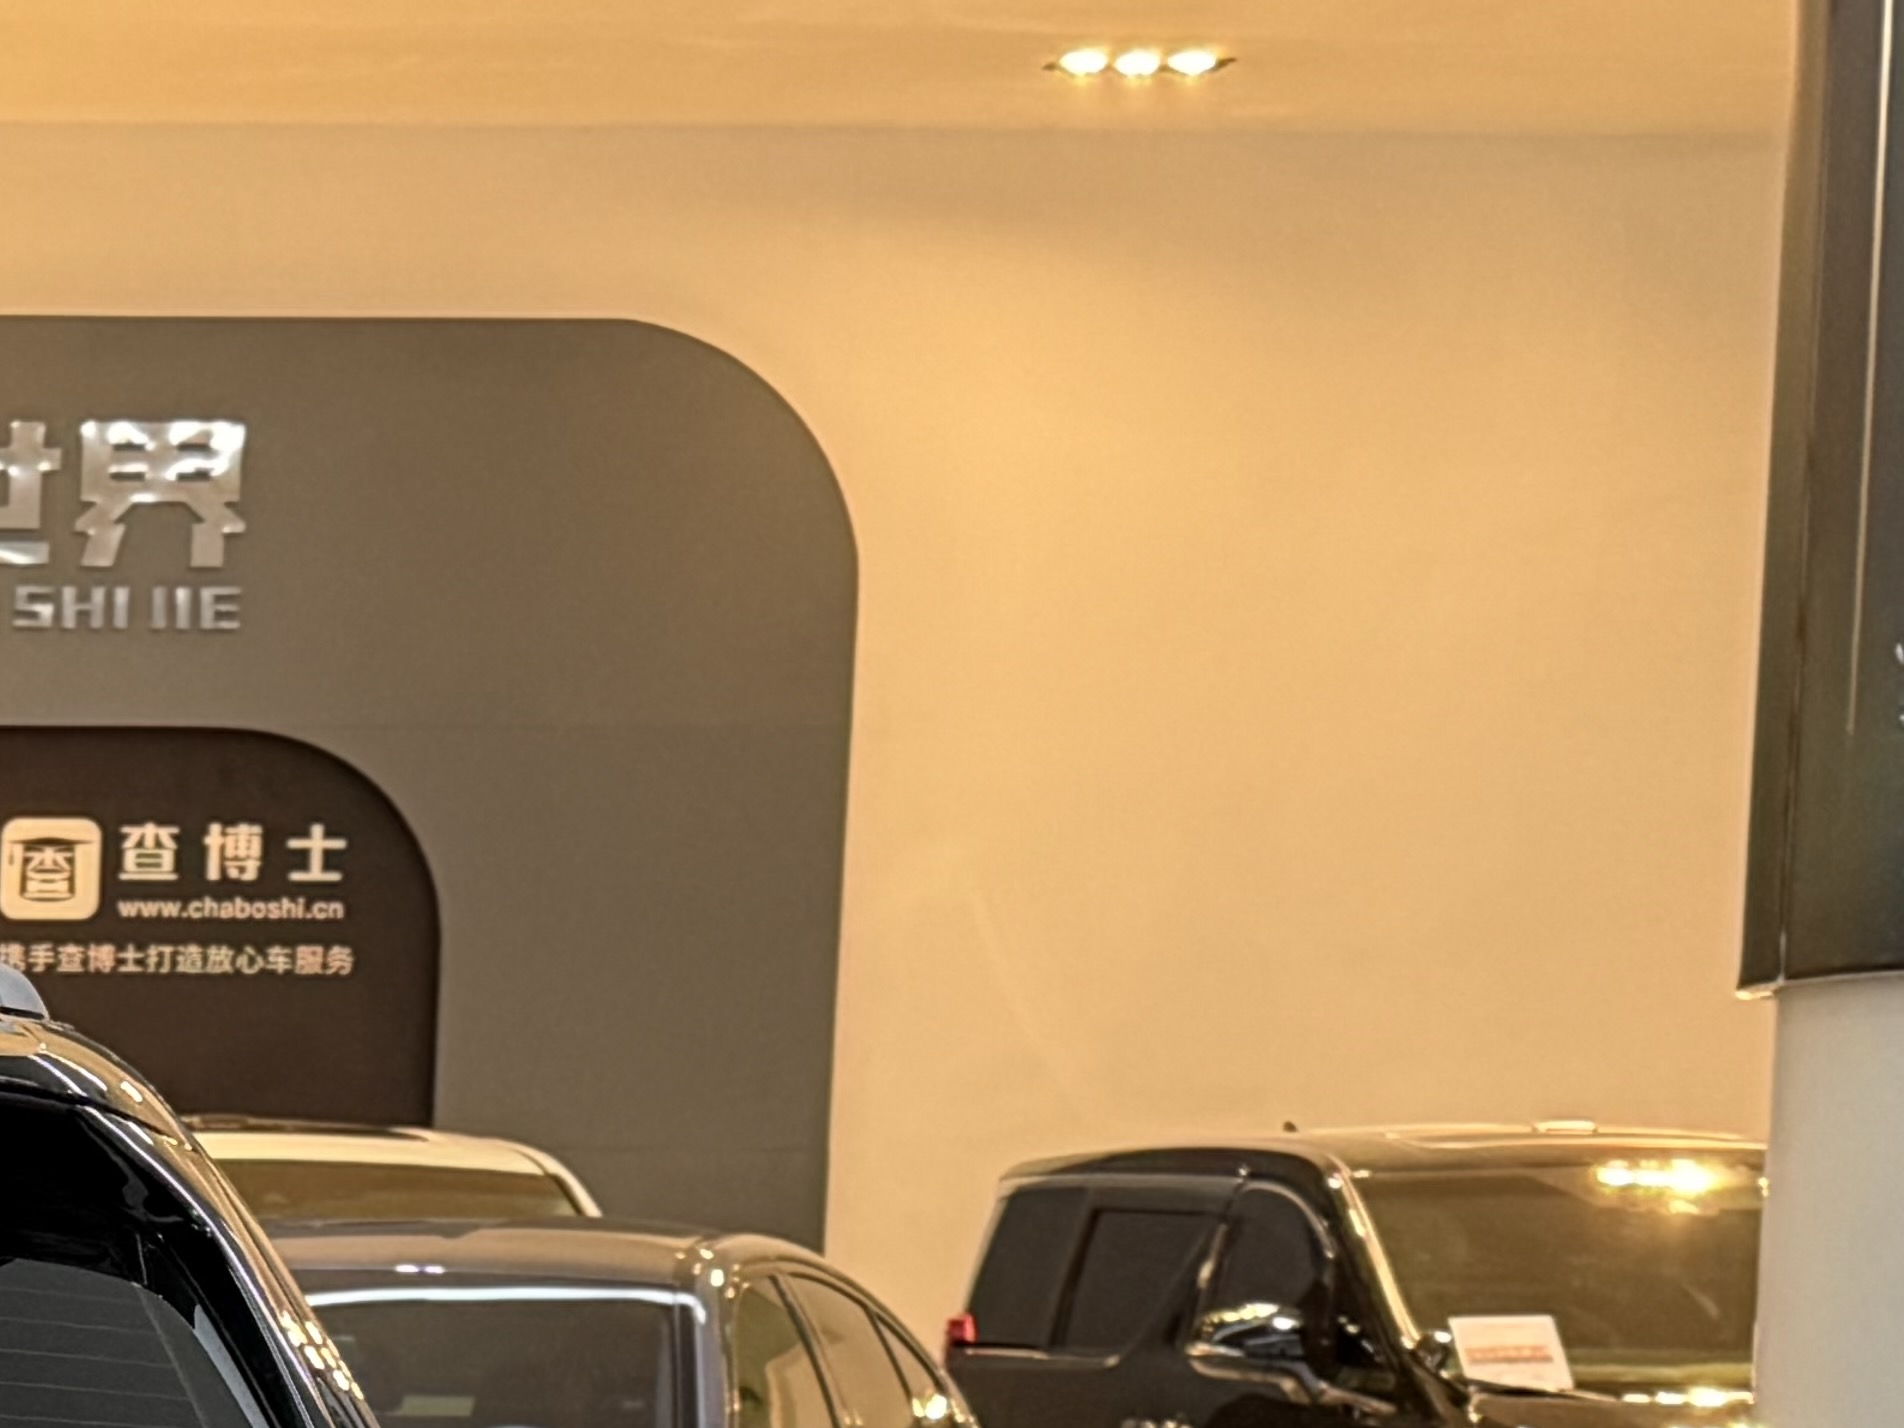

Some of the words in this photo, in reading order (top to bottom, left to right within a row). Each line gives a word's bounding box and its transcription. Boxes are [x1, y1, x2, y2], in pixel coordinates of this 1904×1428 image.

[12, 585, 131, 630] SHI
[118, 822, 347, 882] 查博士
[118, 899, 345, 919] www.chaboshi.cn
